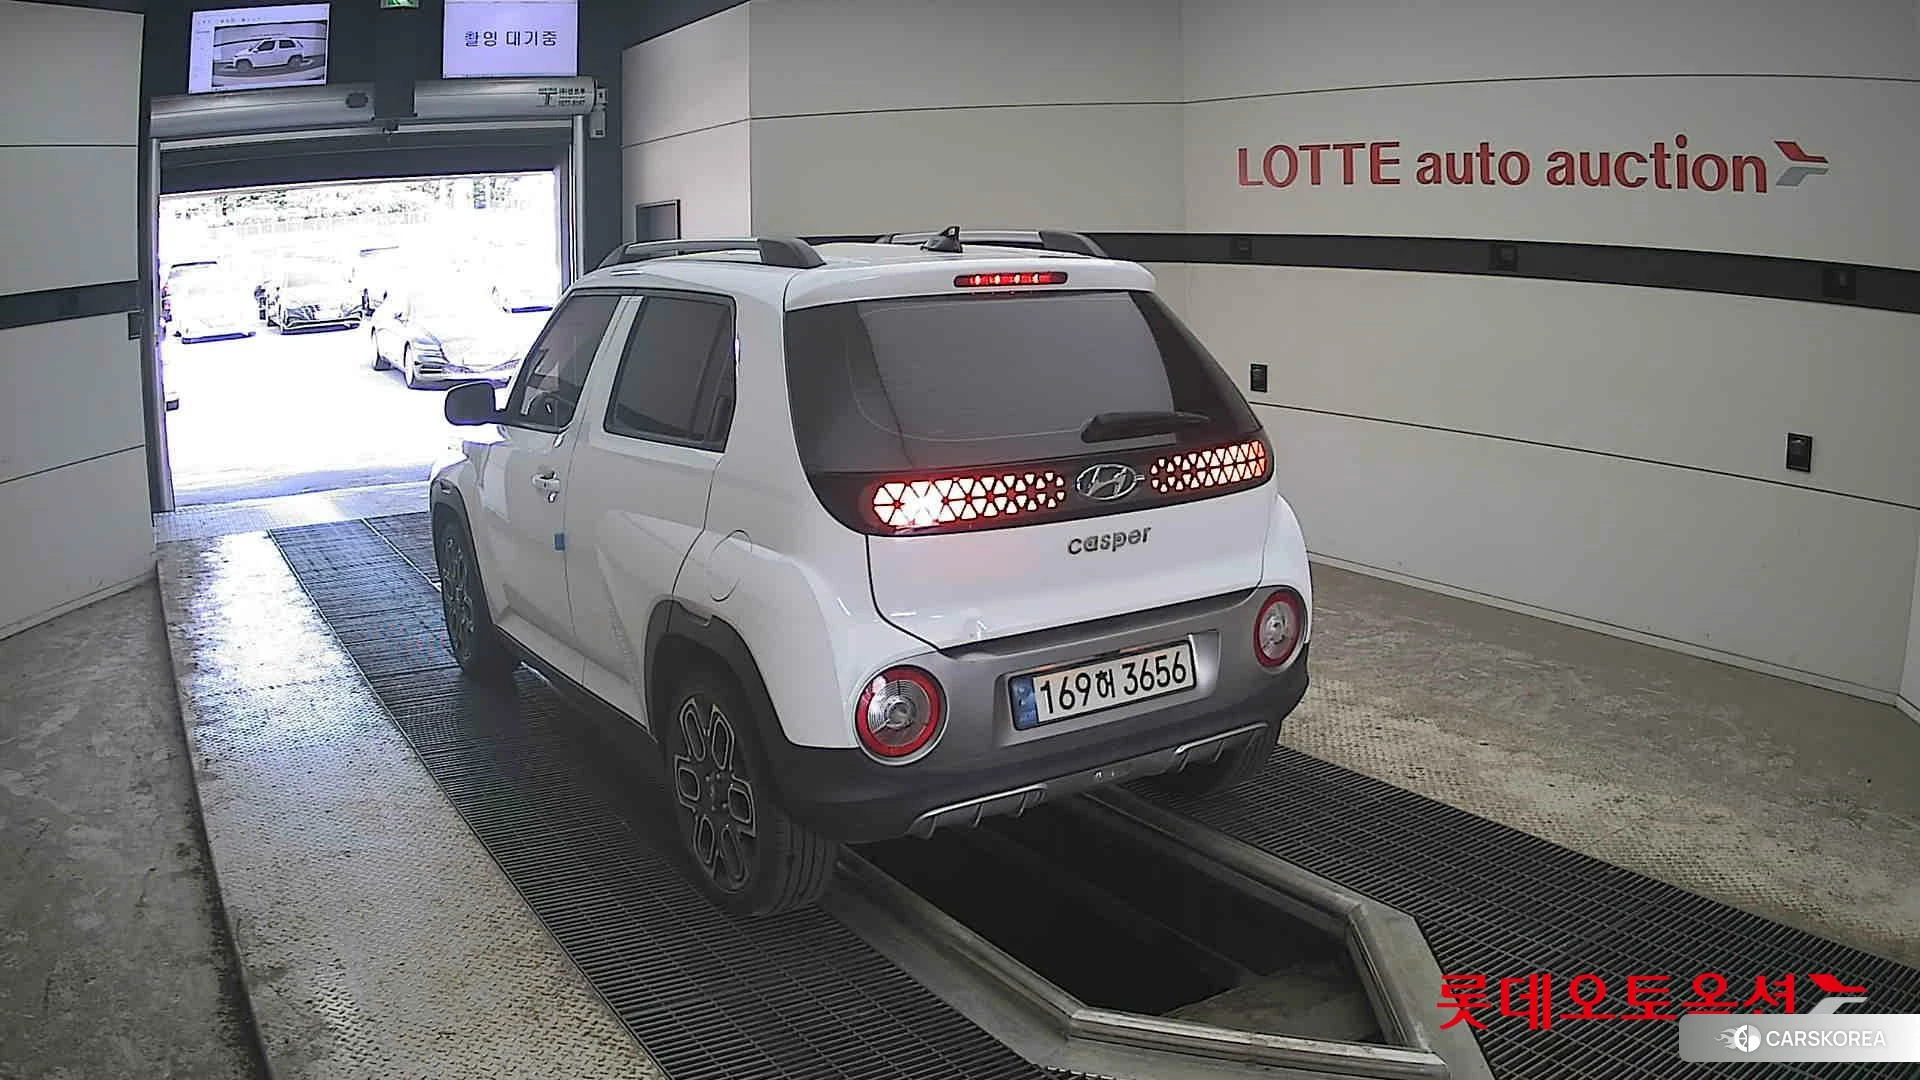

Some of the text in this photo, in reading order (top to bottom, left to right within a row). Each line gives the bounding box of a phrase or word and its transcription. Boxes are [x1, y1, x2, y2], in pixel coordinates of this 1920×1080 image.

[506, 31, 558, 47] 대기중
[1237, 134, 1769, 194] LOTTE auto auction
[1067, 526, 1152, 555] casper
[1121, 651, 1187, 696] 3656
